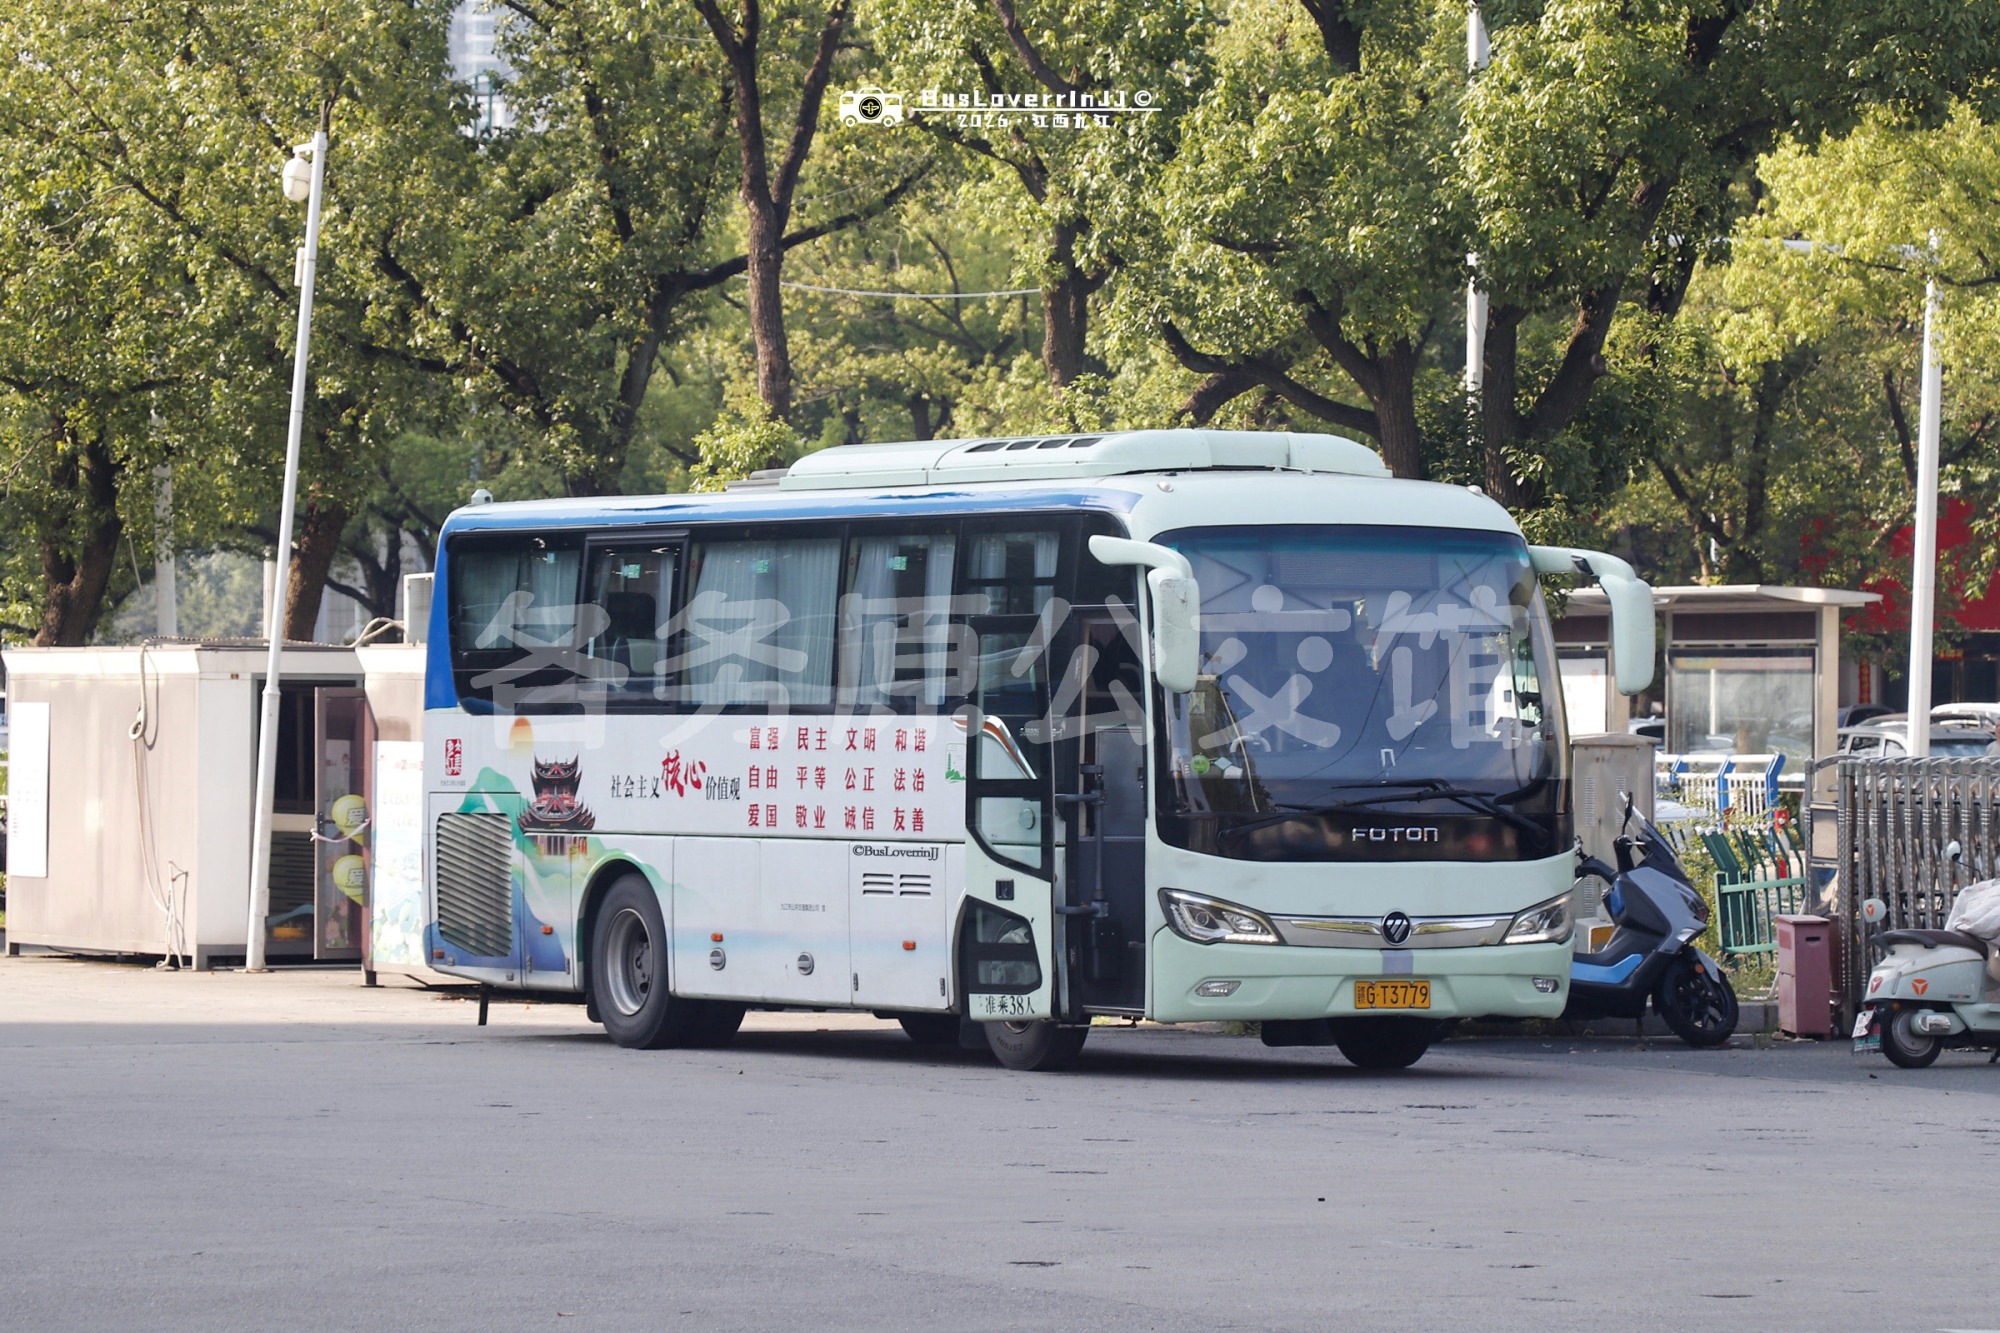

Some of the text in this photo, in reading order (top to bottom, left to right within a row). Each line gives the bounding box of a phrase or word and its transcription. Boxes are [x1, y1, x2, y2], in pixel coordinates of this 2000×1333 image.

[750, 727, 926, 752] 富强 民主 文明 和谐
[748, 765, 925, 792] 自由 平等 公正 法治
[748, 803, 924, 832] 爱国 敬业 诚信 友善
[1352, 827, 1439, 842] FOTON
[985, 995, 1036, 1016] 准乘38人
